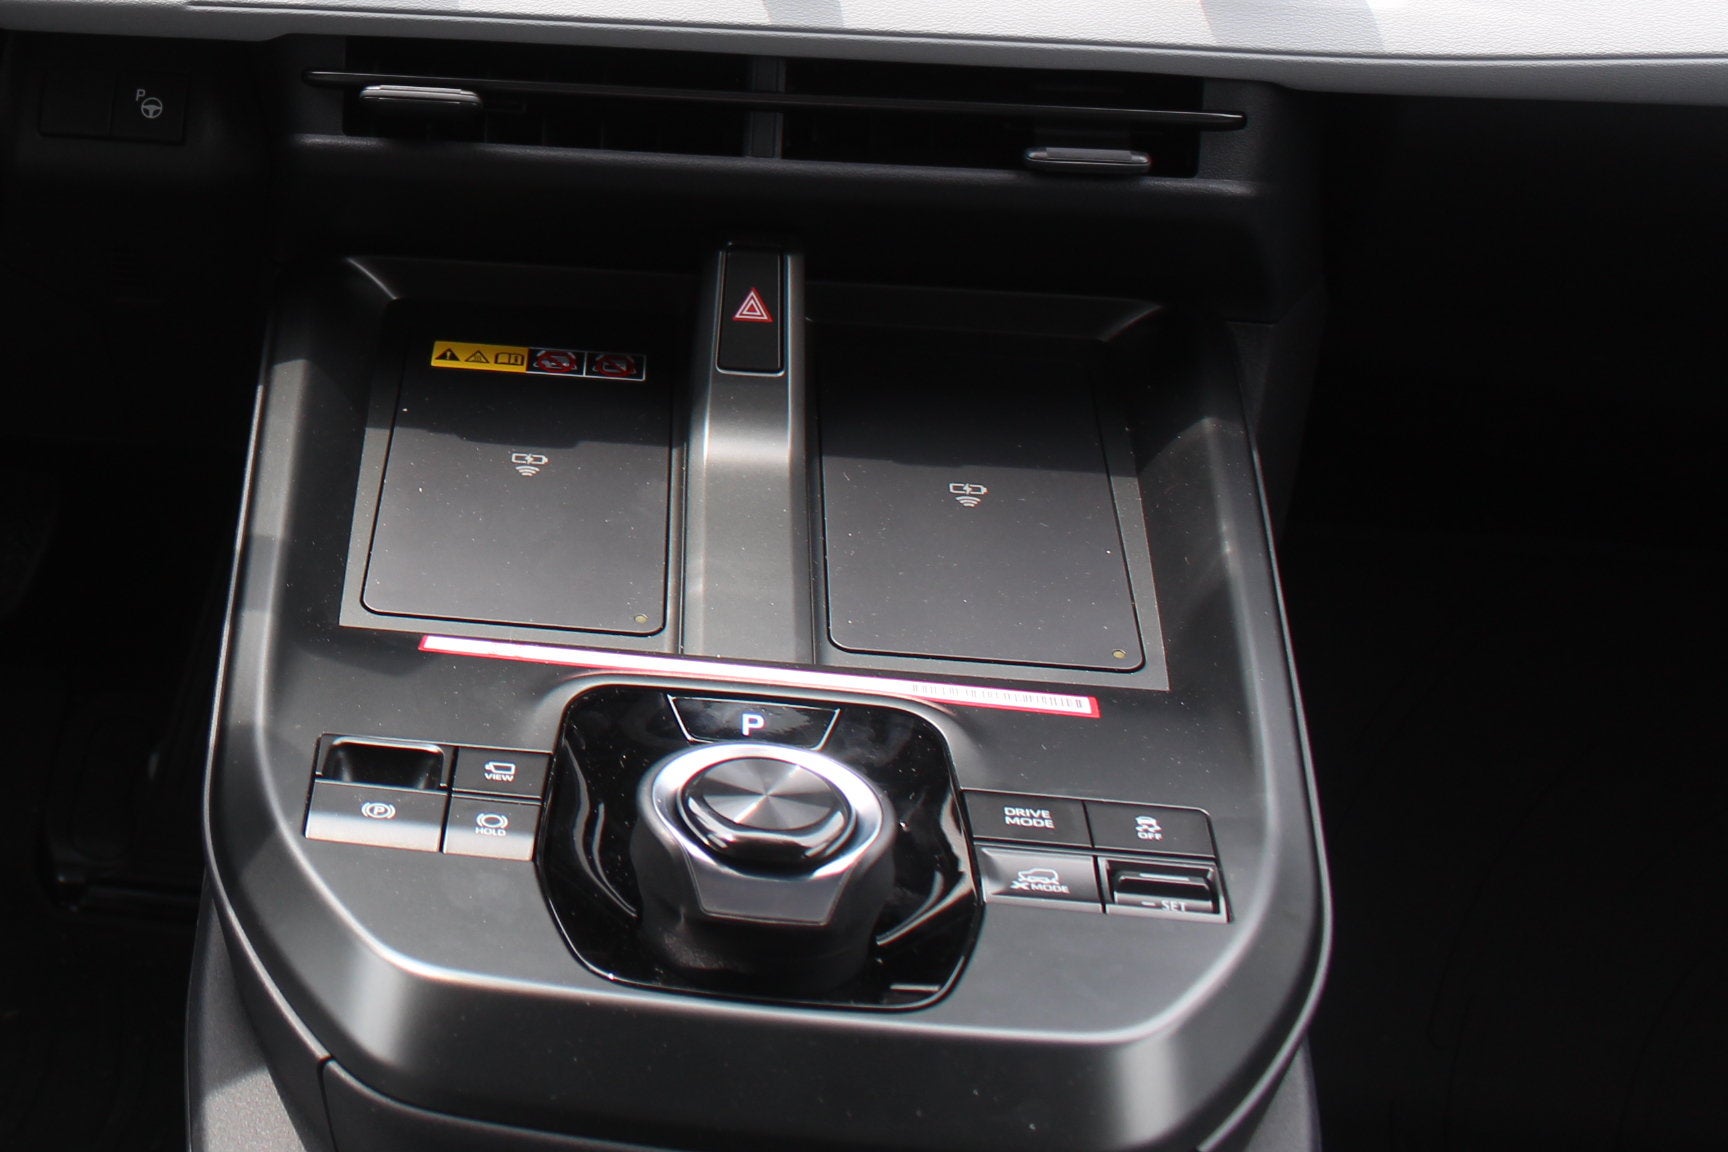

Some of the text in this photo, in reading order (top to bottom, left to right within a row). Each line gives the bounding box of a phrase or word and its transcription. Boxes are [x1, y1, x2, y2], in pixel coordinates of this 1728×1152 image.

[740, 712, 766, 735] P
[485, 771, 515, 781] VIEW
[1004, 807, 1052, 821] DRIVE
[1005, 815, 1054, 828] MODE
[473, 826, 508, 838] HOLD
[1138, 830, 1162, 840] OFF
[1031, 884, 1069, 893] MODE
[1162, 901, 1187, 912] SET
